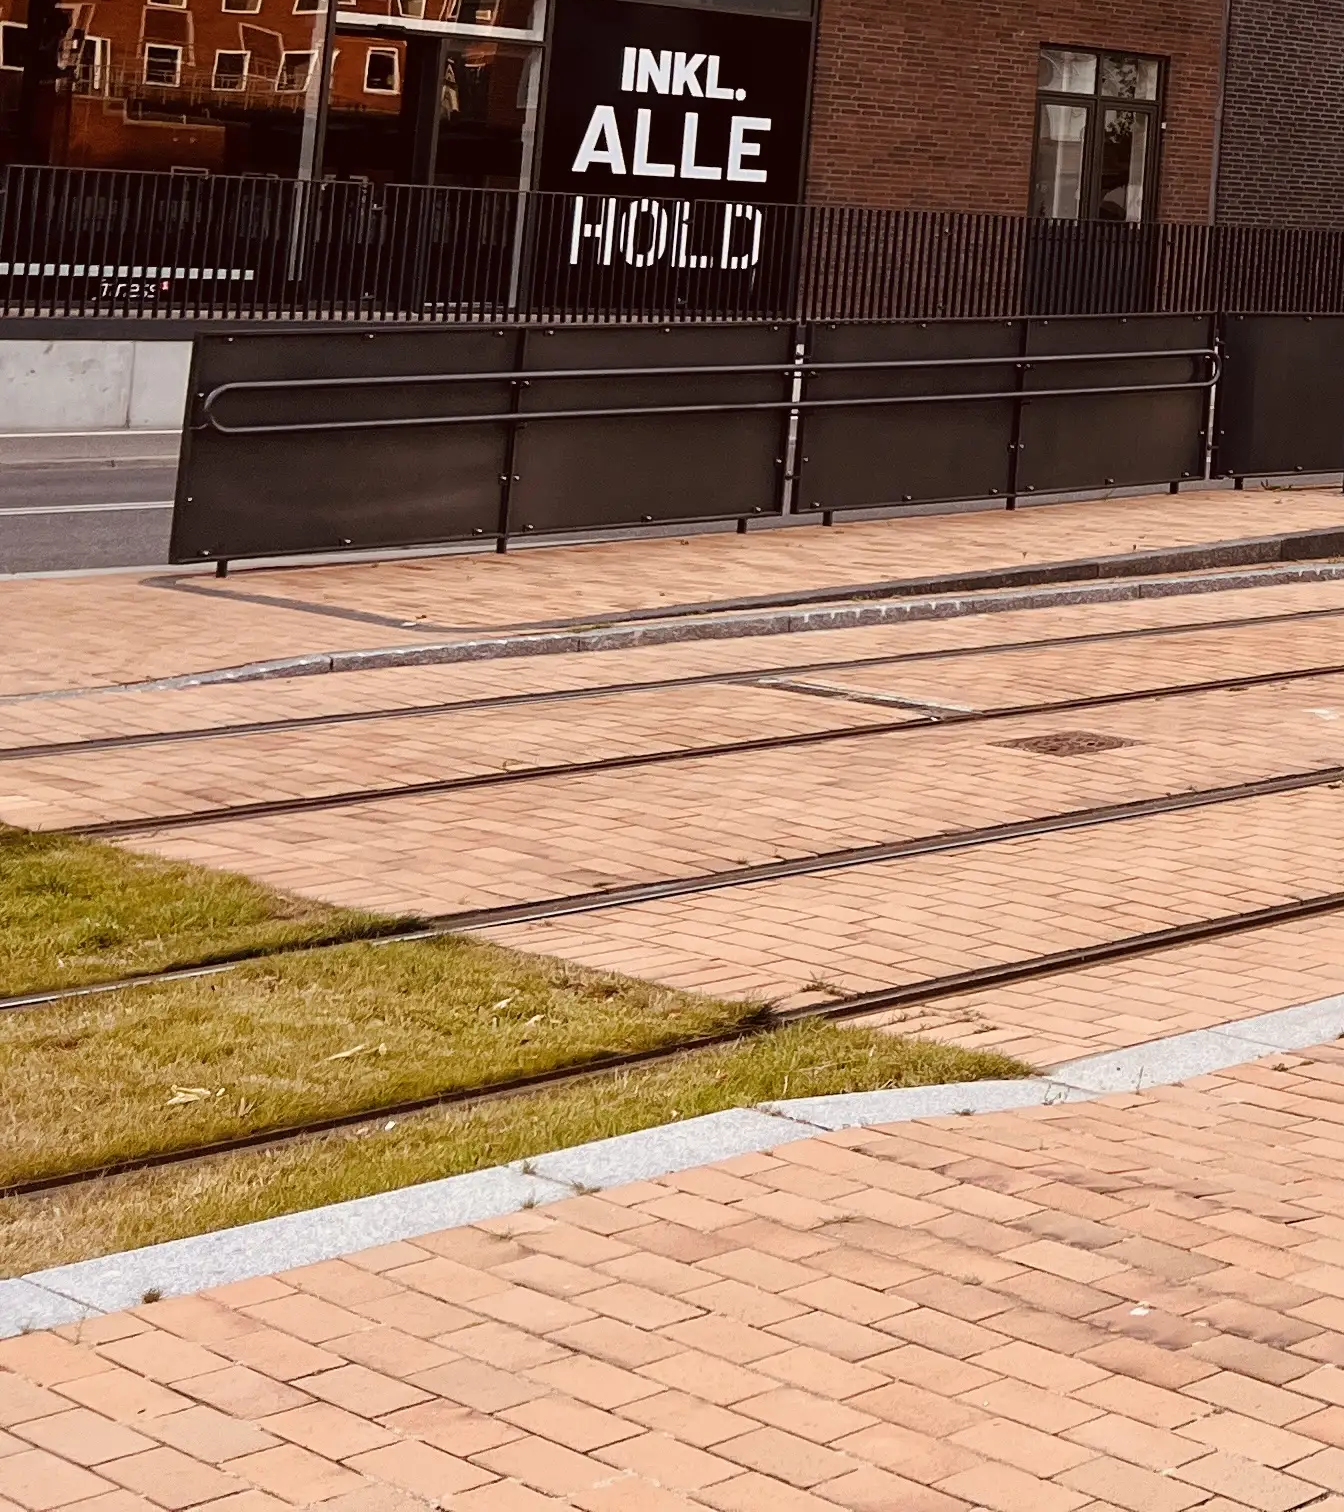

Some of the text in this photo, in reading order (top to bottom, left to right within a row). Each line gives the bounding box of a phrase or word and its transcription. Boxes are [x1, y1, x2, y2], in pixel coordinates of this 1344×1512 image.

[620, 46, 747, 101] INKL.
[571, 104, 772, 183] ALLE
[568, 195, 763, 270] HOLD
